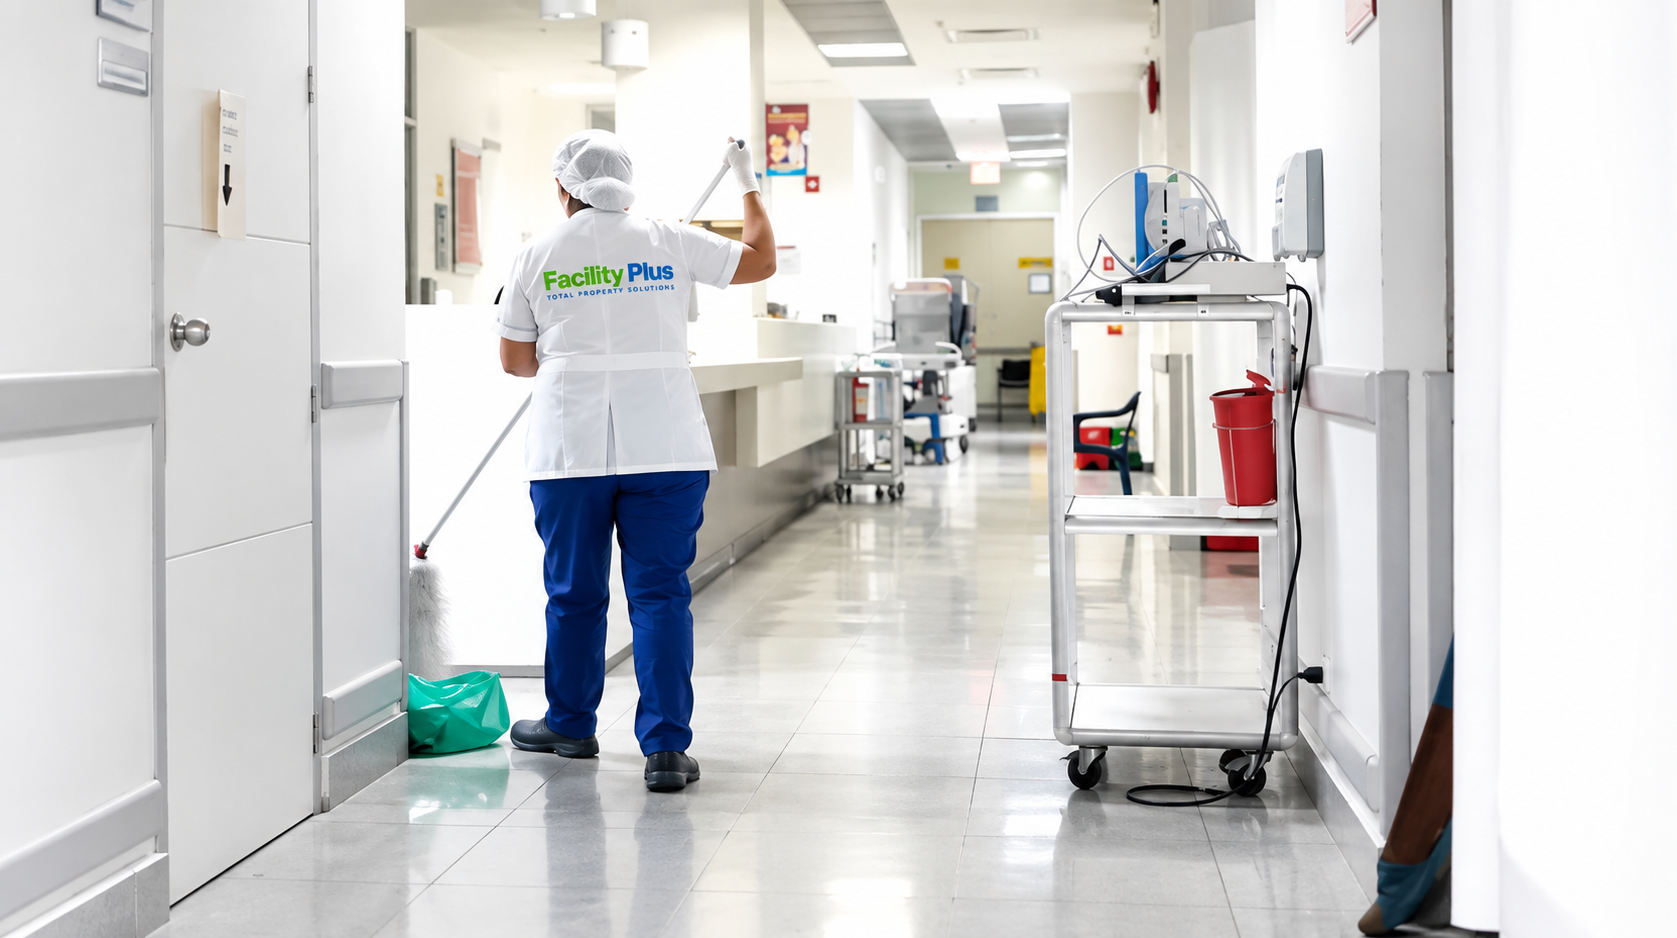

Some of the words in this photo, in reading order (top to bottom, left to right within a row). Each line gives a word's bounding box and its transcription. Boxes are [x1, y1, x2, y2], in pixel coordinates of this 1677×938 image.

[543, 265, 624, 291] Facility
[627, 262, 674, 282] Plus
[546, 292, 574, 301] TOTAL
[578, 287, 623, 297] PROPERTY
[627, 284, 675, 293] SOLUTIONS
